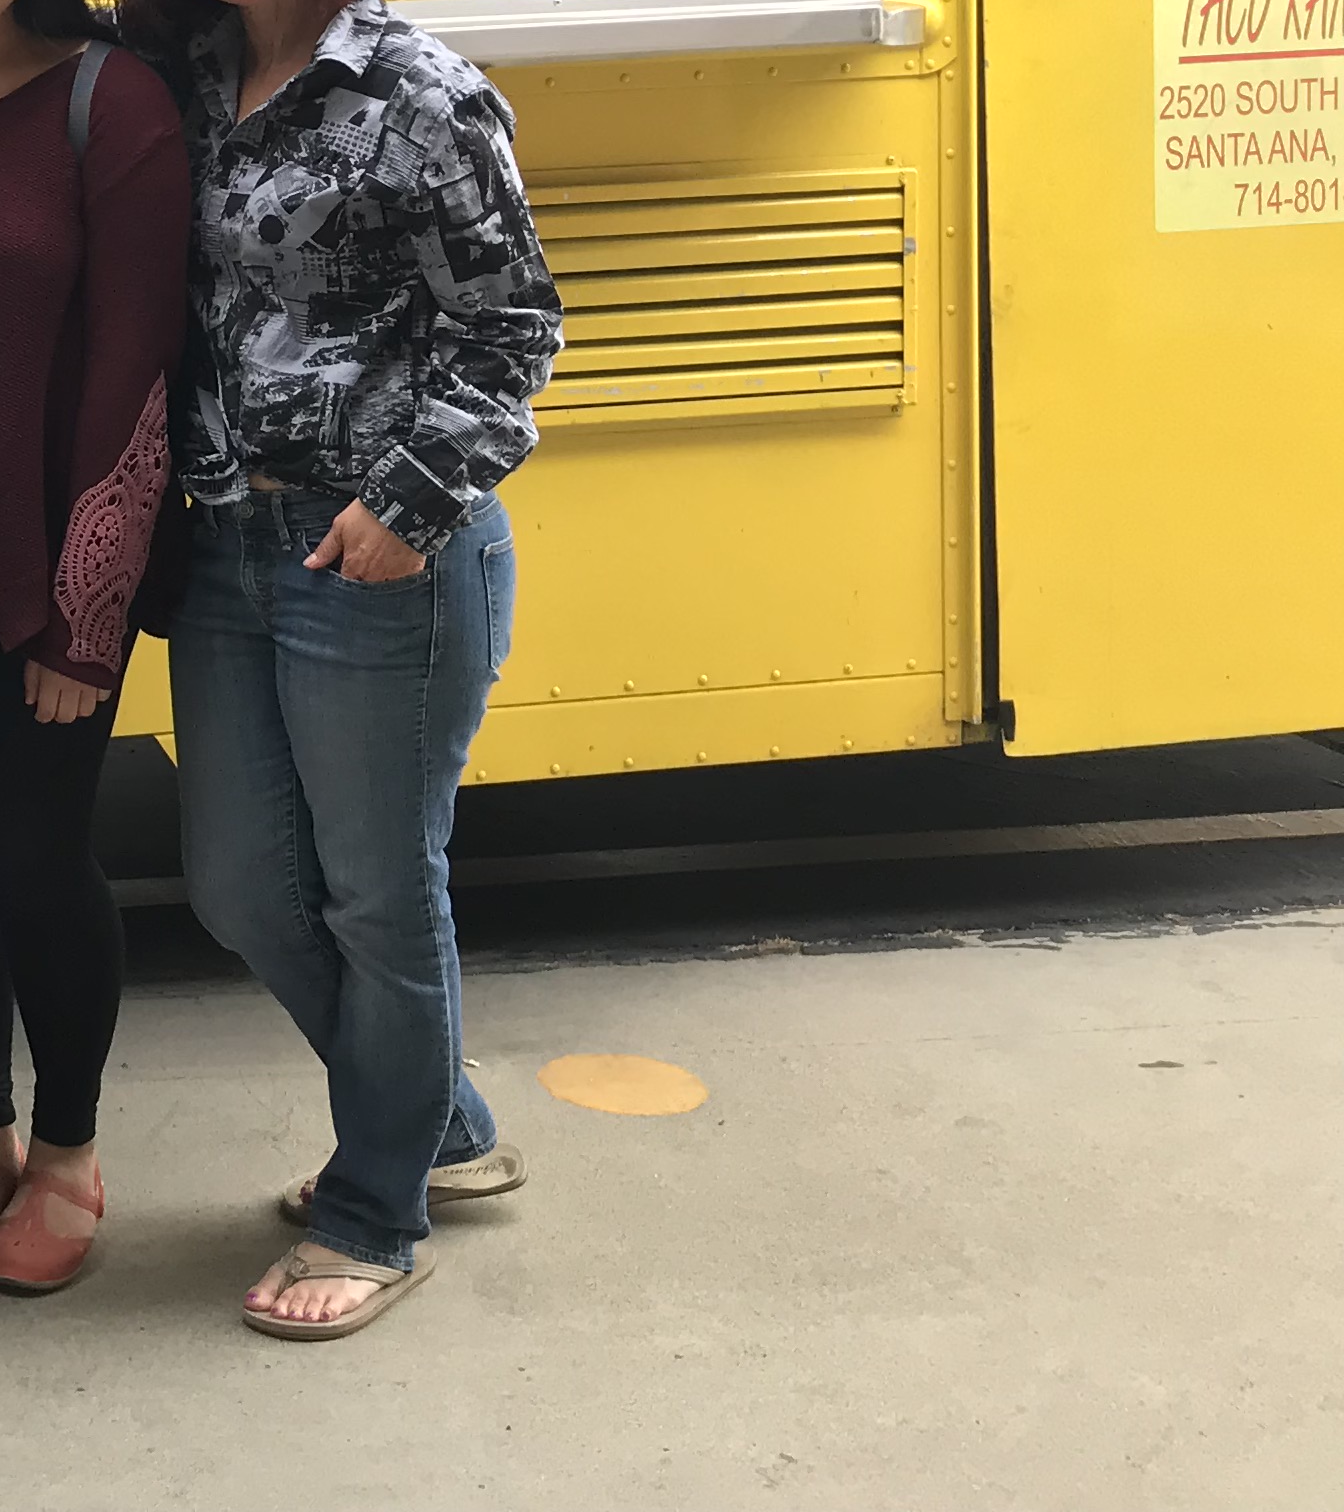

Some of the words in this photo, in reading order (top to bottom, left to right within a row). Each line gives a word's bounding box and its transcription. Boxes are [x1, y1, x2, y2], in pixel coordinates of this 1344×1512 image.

[1159, 83, 1226, 120] 2520
[1236, 77, 1339, 115] SOUTH
[1165, 131, 1264, 171] SANTA
[1267, 128, 1337, 168] ANA,
[1234, 178, 1344, 217] 714-801
